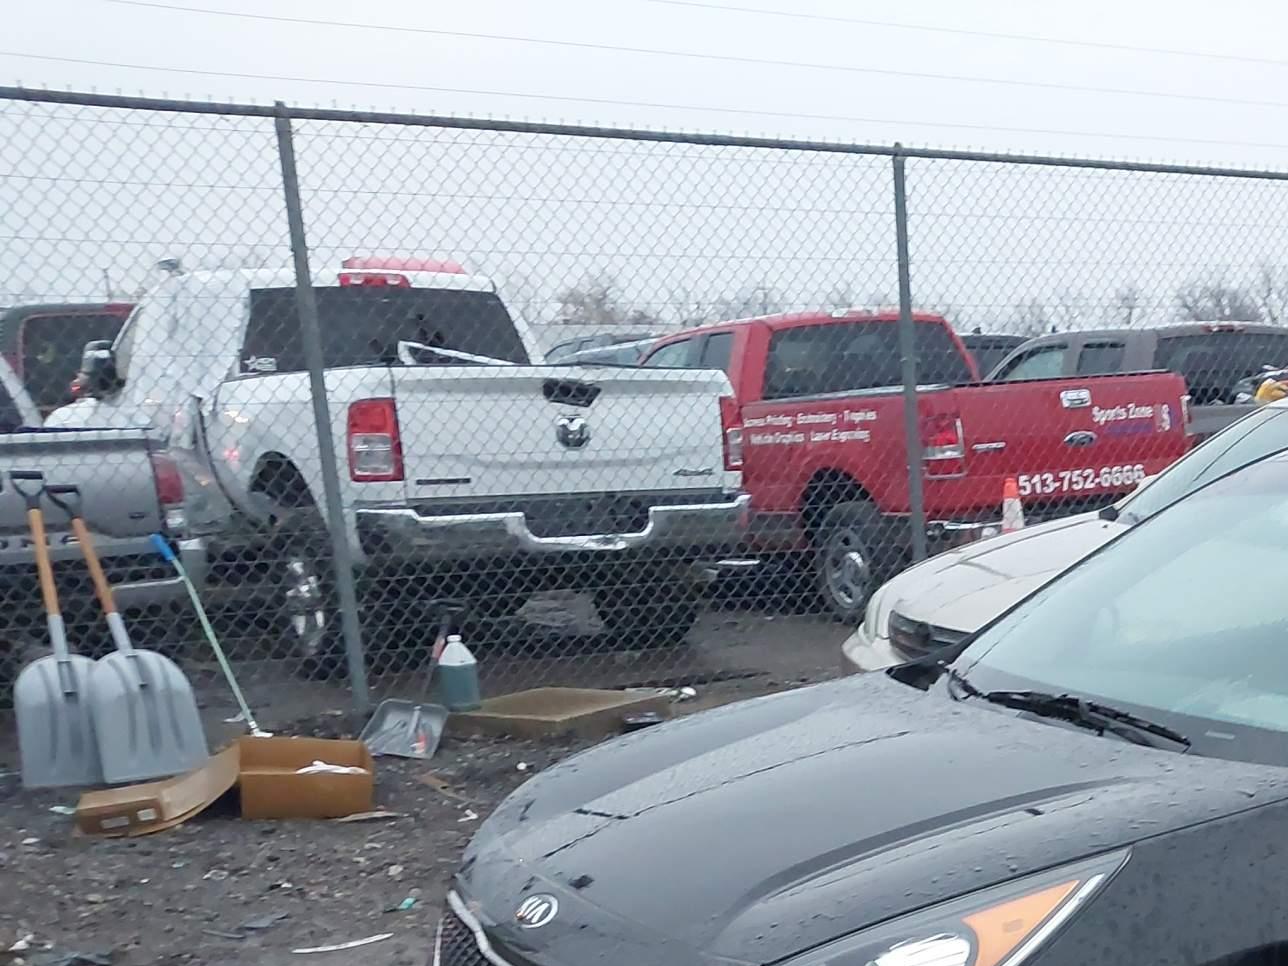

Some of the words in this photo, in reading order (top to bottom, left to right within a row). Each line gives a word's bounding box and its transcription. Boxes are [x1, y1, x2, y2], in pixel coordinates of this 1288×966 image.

[1091, 406, 1127, 426] Sports
[1127, 402, 1154, 419] Zone
[1017, 463, 1147, 496] 513-752-6666
